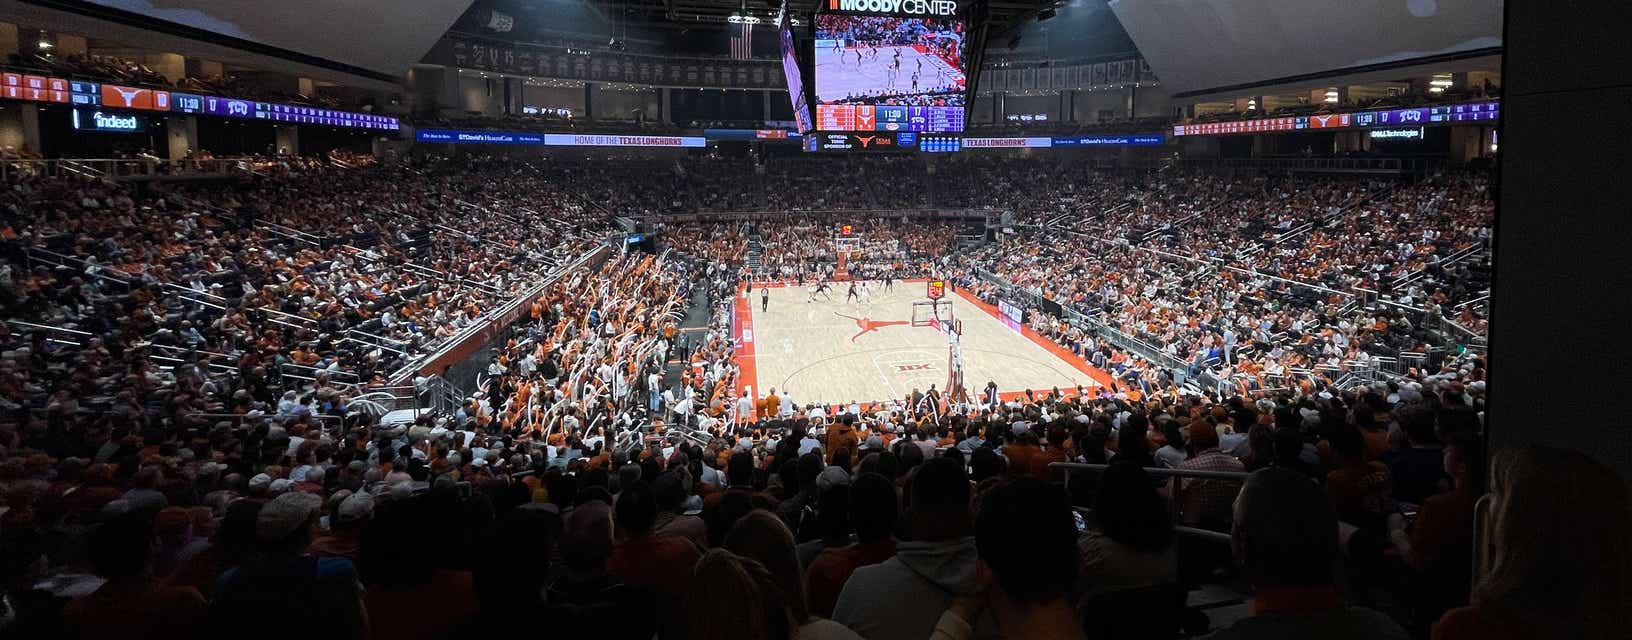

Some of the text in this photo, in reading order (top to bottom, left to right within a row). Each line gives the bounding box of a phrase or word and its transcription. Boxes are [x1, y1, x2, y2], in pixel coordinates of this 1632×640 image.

[840, 0, 957, 15] MOODY CENTER
[228, 101, 248, 115] TCU
[94, 112, 136, 128] indeed
[1400, 110, 1421, 122] TCU
[574, 136, 594, 144] HOME
[596, 136, 605, 144] OF
[619, 137, 641, 145] TEXAS
[642, 137, 682, 145] LONGHORNS
